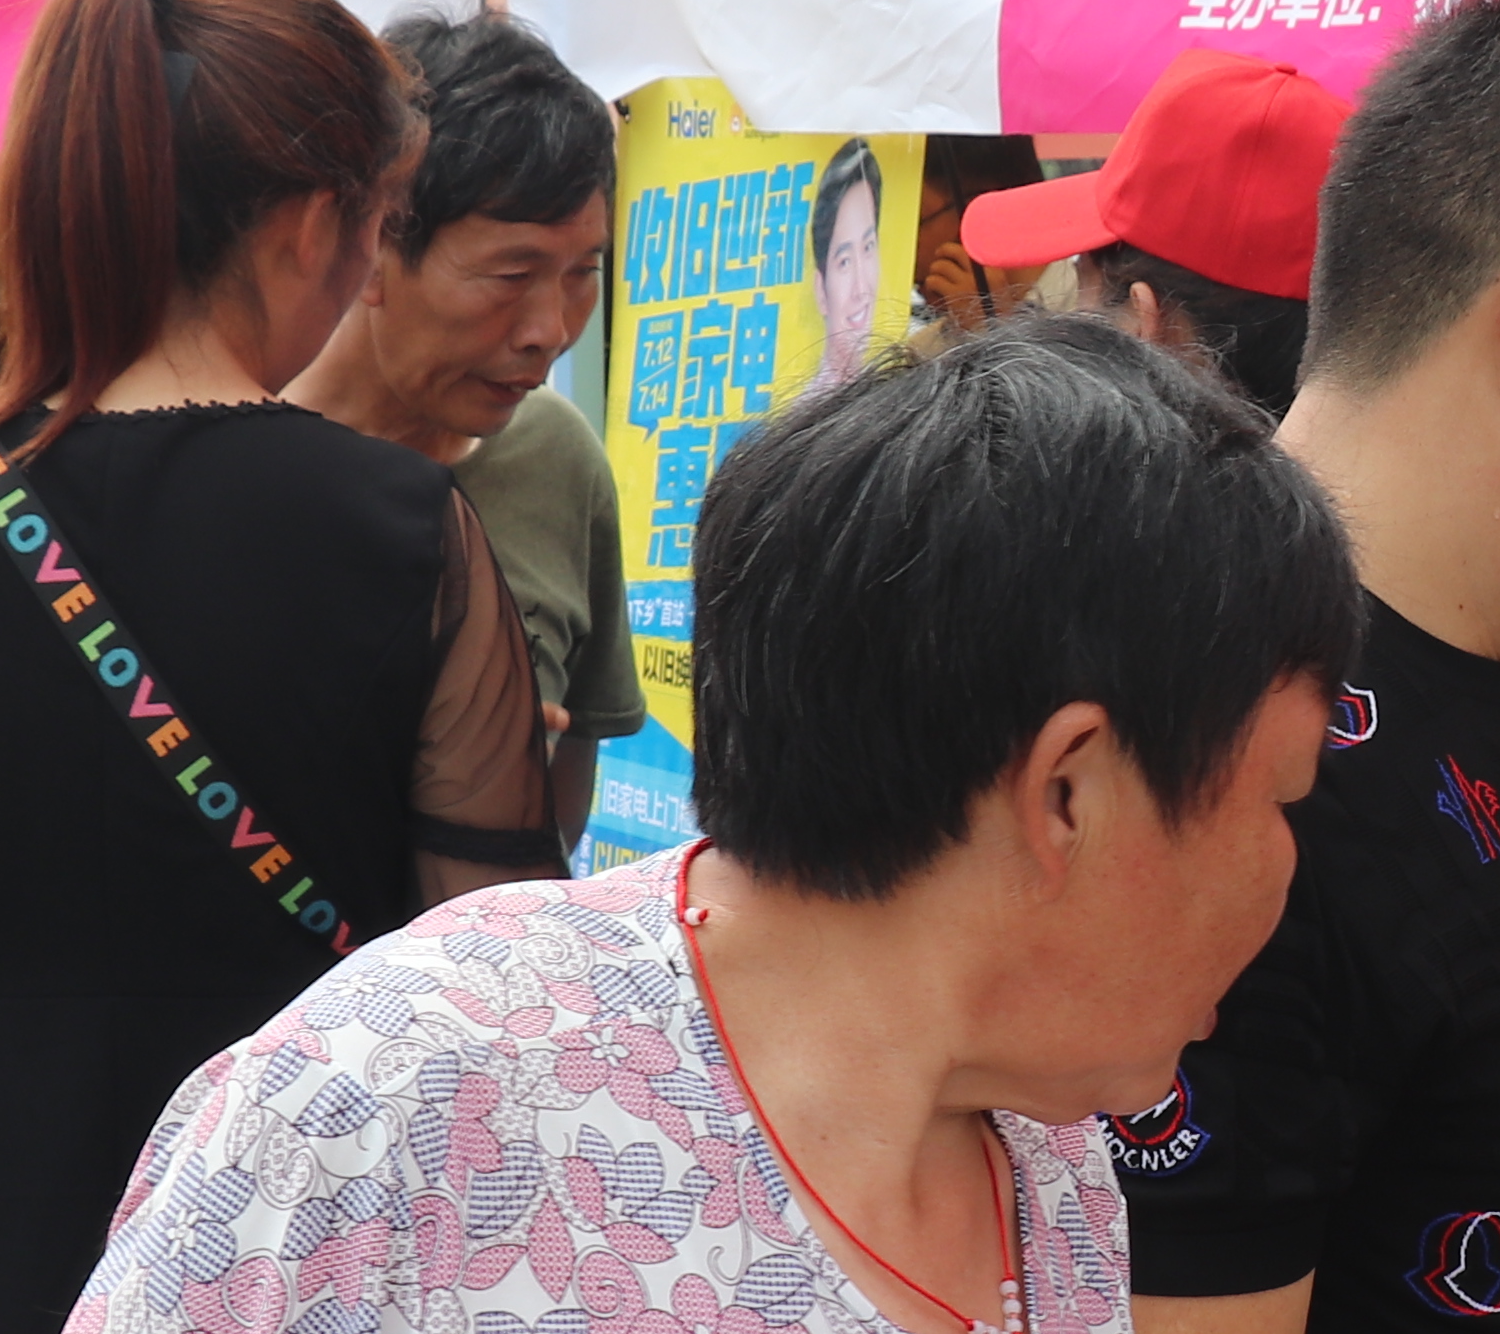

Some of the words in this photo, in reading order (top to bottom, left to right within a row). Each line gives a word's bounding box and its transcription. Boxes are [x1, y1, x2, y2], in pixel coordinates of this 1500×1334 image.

[666, 98, 717, 139] Haier
[623, 160, 815, 306] 收旧迎新
[637, 380, 669, 413] 7.14
[643, 336, 675, 368] 7.12
[679, 291, 780, 419] 家电
[78, 619, 191, 757] LOVE
[174, 754, 293, 884] LOVE
